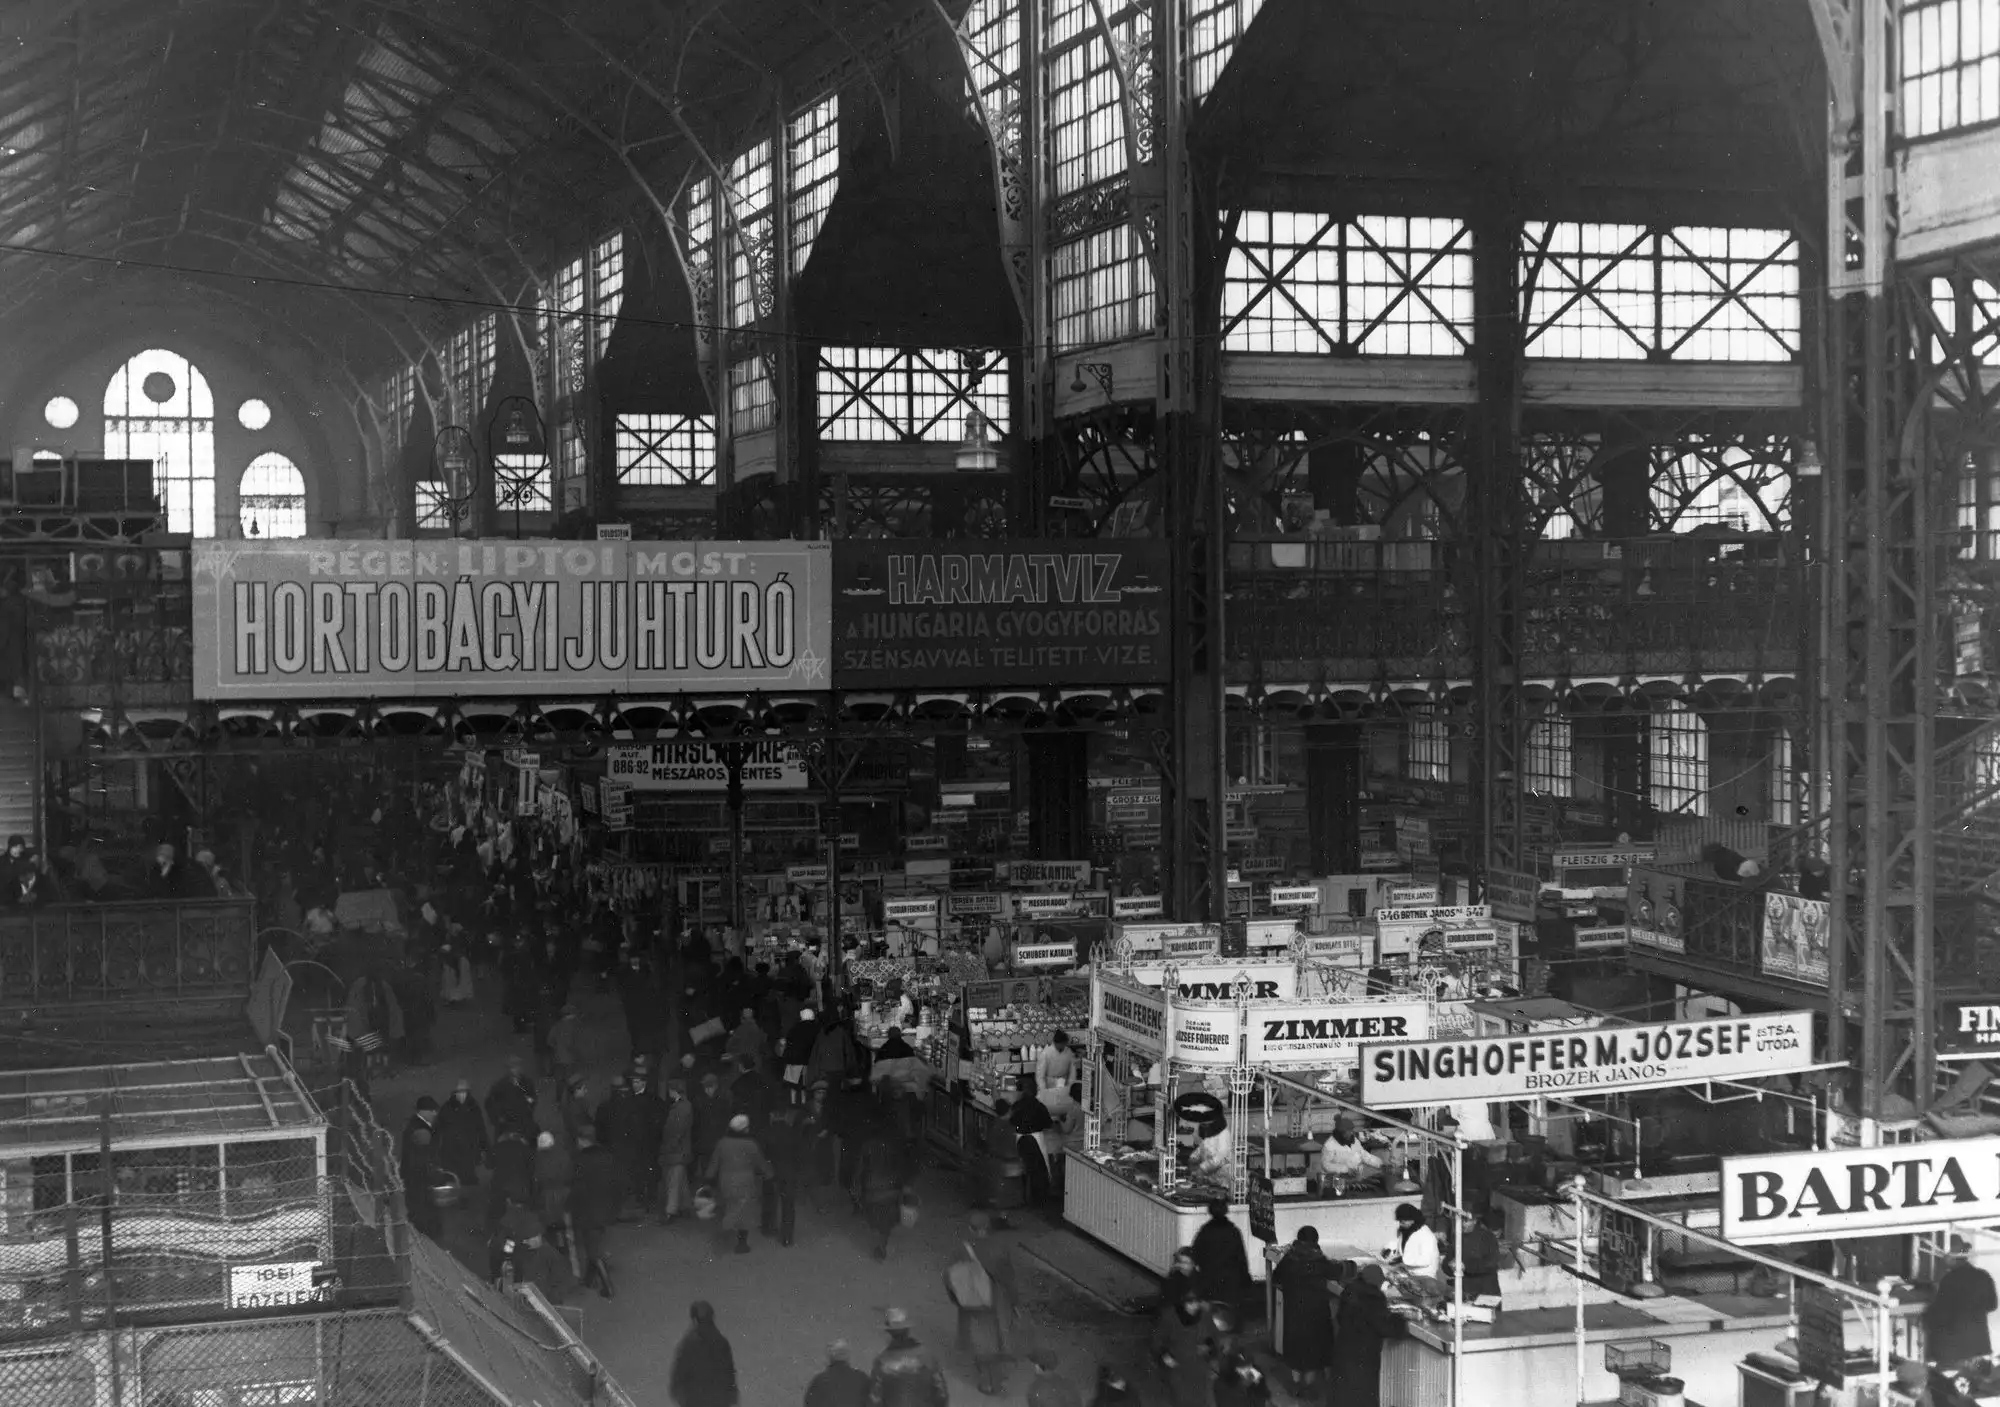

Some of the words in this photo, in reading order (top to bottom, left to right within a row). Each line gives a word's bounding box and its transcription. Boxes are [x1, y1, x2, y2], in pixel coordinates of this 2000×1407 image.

[309, 543, 449, 576] RÉGEN:
[636, 551, 757, 576] MOST:
[888, 554, 1122, 604] HARMATVIZ
[234, 574, 559, 674] HORTOBÁGYI
[564, 572, 795, 672] JUHTURÓ
[652, 765, 726, 780] MÉSZÁROS
[741, 767, 782, 780] ENTES
[1561, 855, 1608, 865] FLEISZIG
[1380, 910, 1401, 921] 546
[1466, 907, 1484, 917] 547
[1018, 949, 1049, 960] SCHUBERT
[1104, 992, 1132, 1019] ZIMMER
[1133, 1001, 1162, 1030] FERENC
[1264, 1016, 1408, 1041] ZIMMER
[1374, 1036, 1588, 1082] SINGHOFFER
[1595, 1034, 1626, 1066] M.
[1631, 1023, 1751, 1062] JÓZSEF
[1738, 1156, 1980, 1222] BARTA
